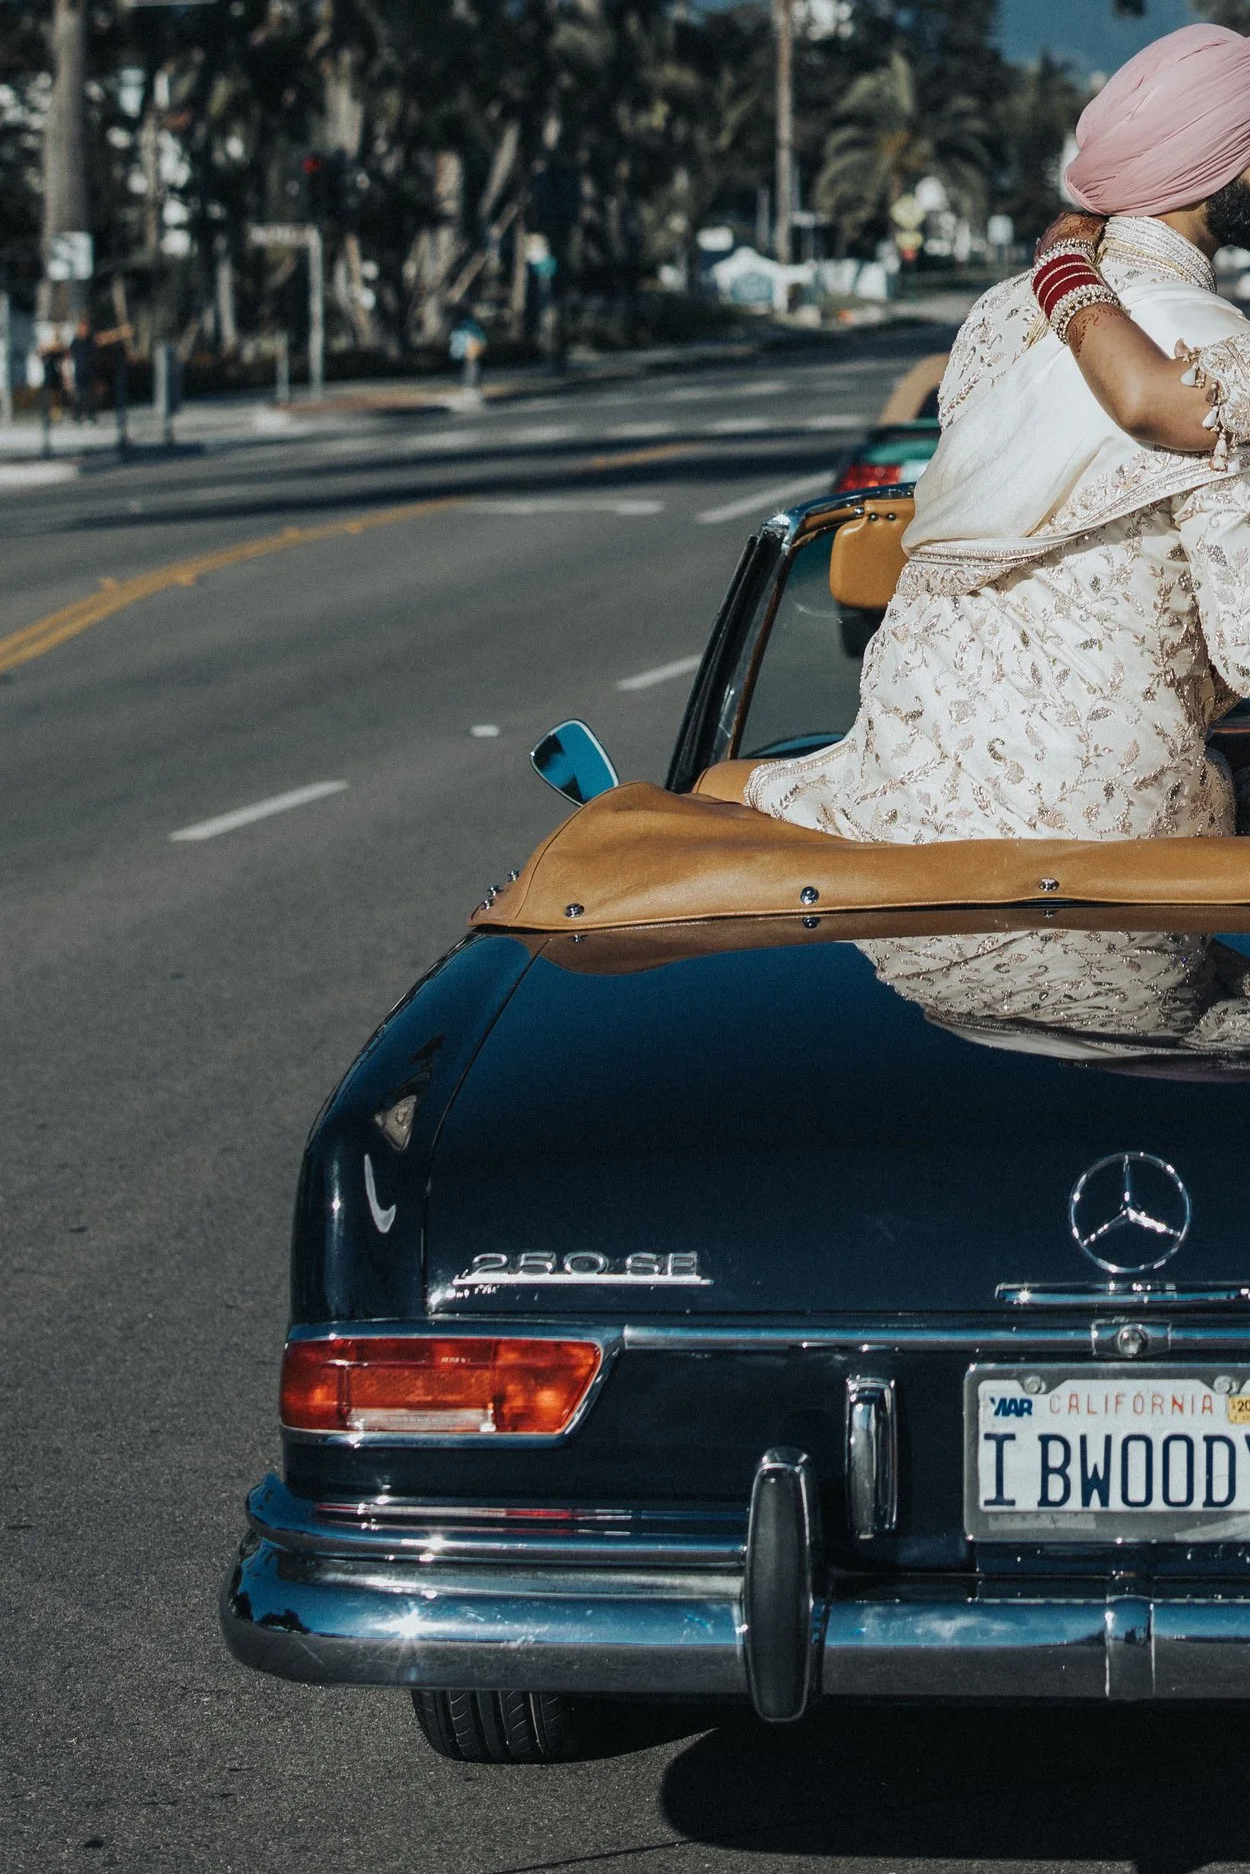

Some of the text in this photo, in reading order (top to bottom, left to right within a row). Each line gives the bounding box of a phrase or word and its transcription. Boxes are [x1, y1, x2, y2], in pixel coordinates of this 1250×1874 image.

[471, 1251, 699, 1277] 250 SE
[1050, 1393, 1214, 1415] CALIFORNIA
[983, 1433, 1017, 1507] I
